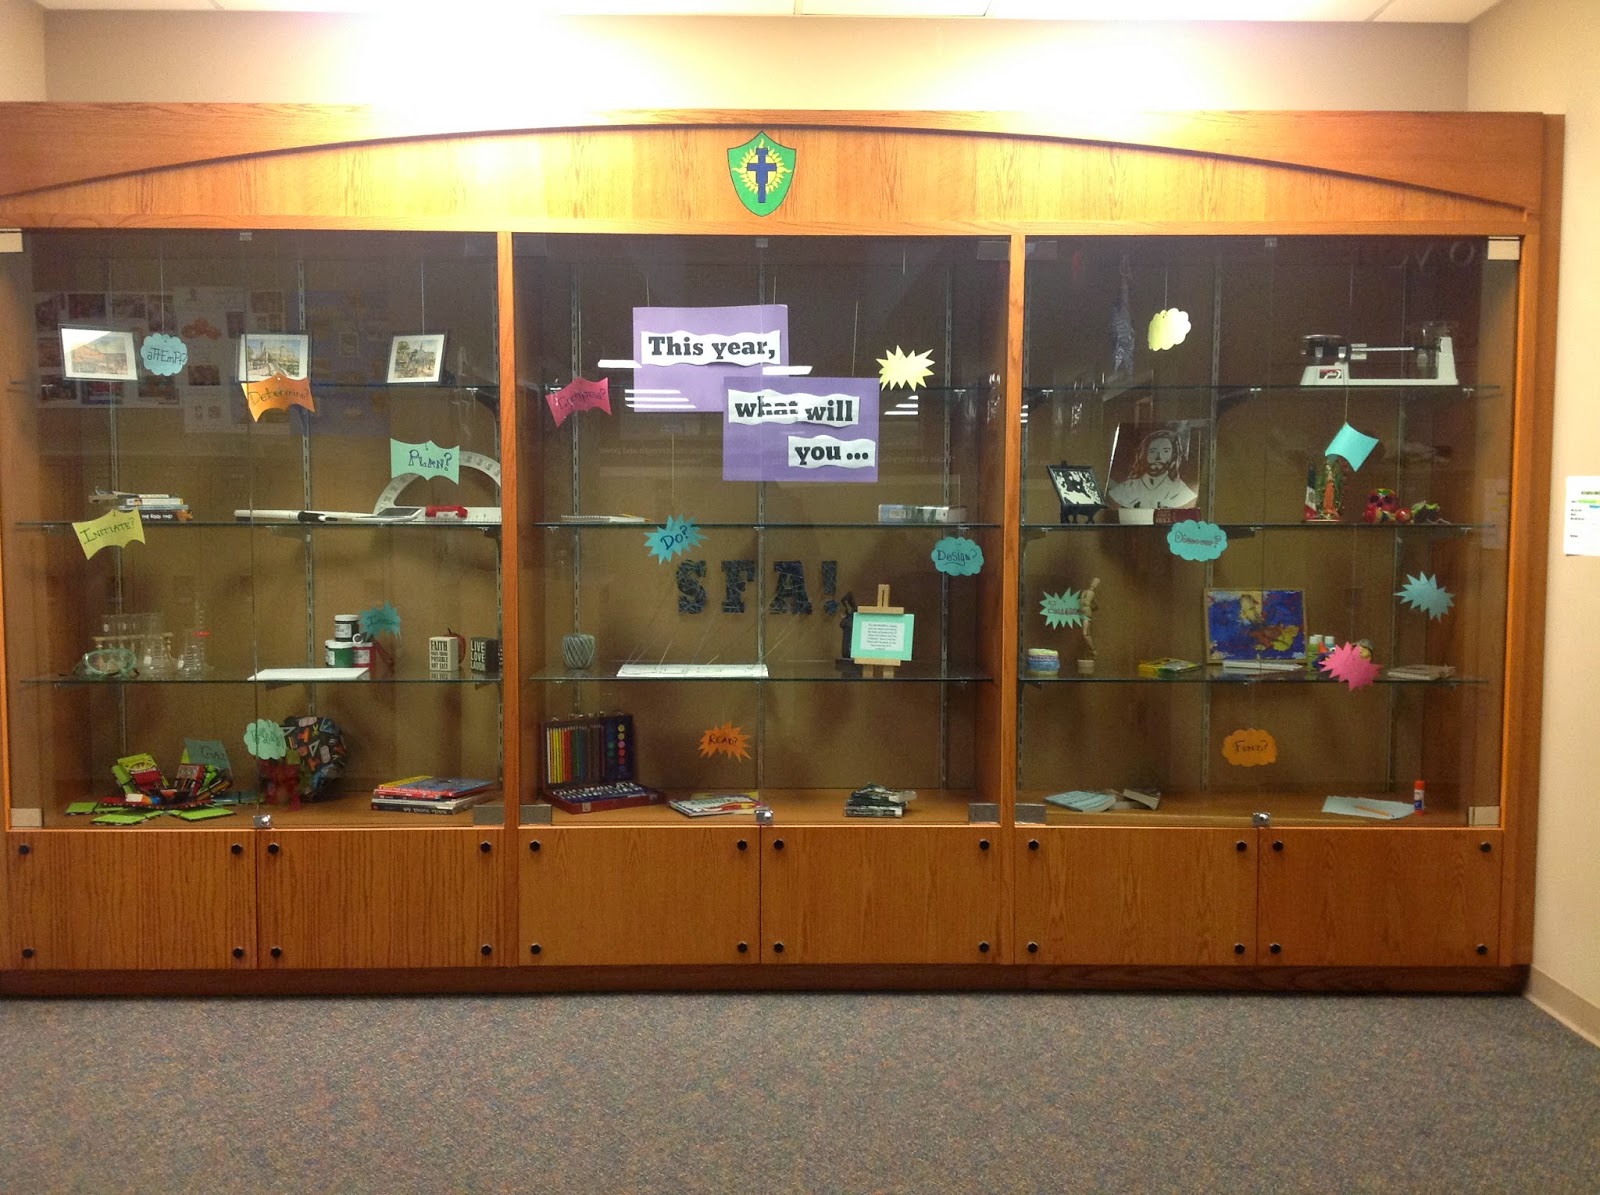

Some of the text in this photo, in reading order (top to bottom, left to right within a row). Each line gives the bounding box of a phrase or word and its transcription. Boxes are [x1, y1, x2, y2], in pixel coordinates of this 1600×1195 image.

[648, 336, 775, 360] This year,
[734, 395, 853, 422] what will
[660, 524, 689, 550] Do?
[676, 559, 839, 616] SFA!
[430, 640, 448, 651] FAITH
[470, 640, 486, 653] LIVE
[470, 651, 486, 663] LOVE
